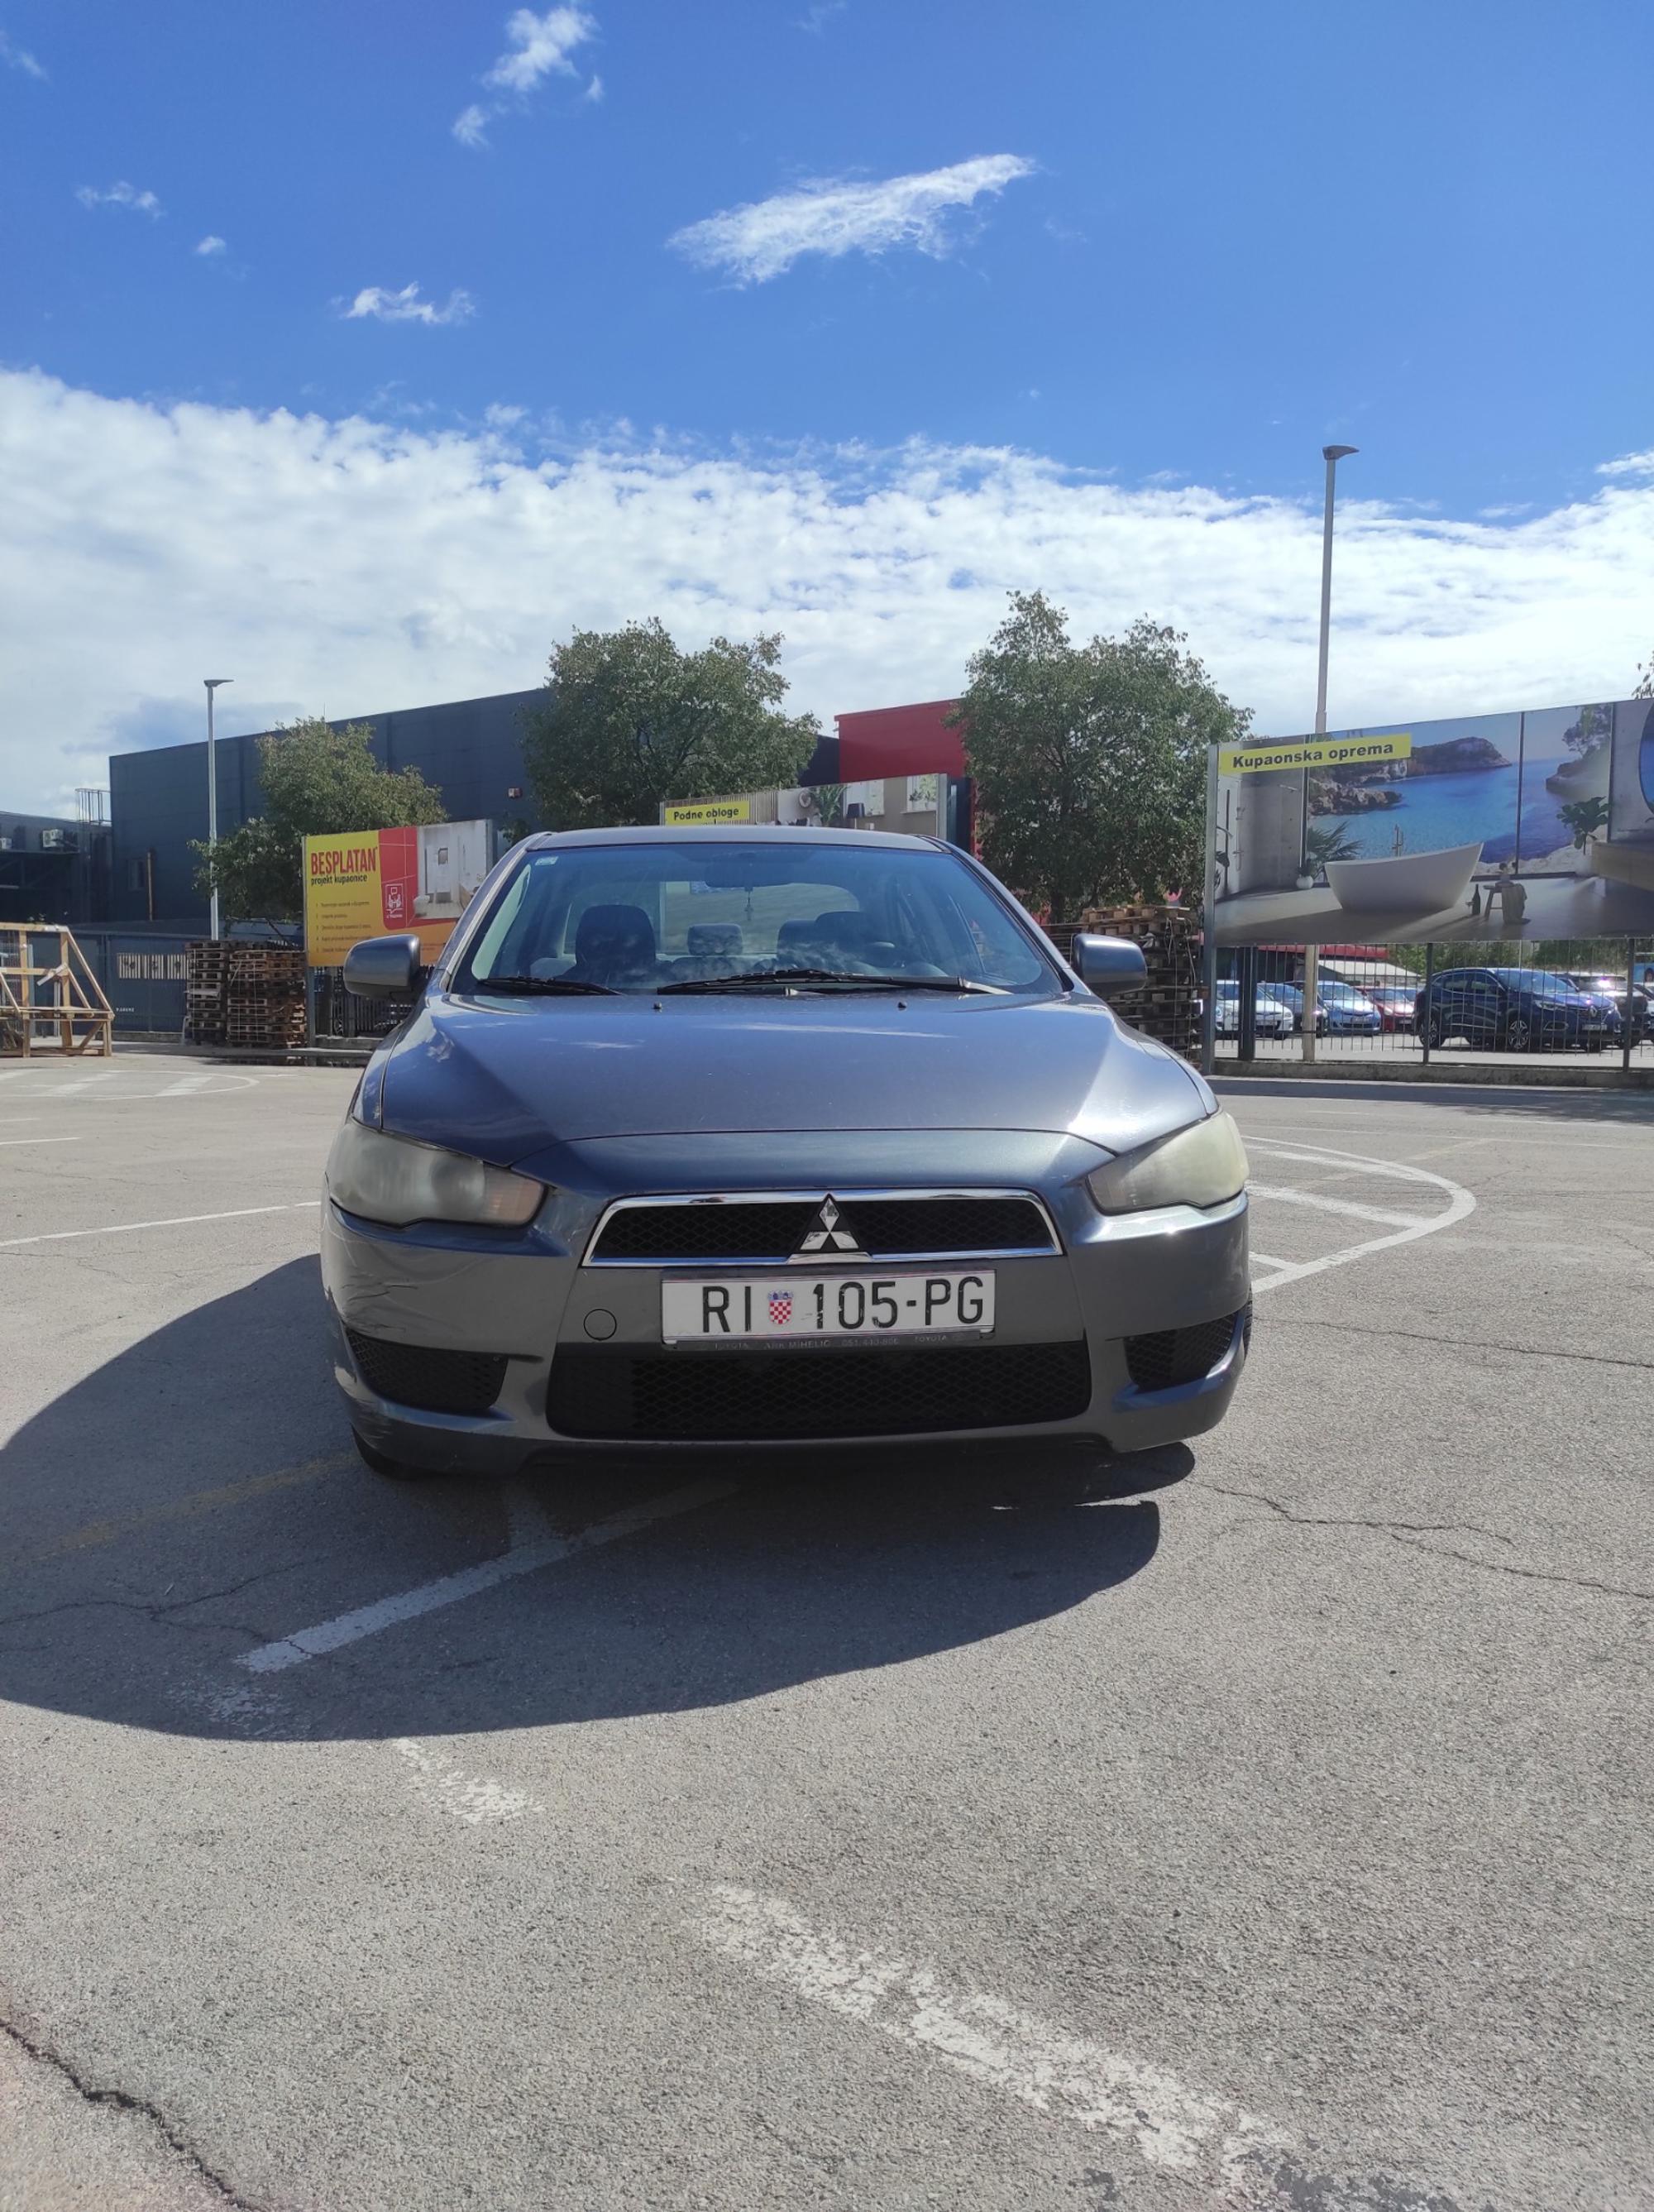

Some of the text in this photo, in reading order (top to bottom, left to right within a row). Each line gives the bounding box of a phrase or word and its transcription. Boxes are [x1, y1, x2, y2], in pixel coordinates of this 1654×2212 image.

[1232, 744, 1393, 769] Kupaonska oprema
[674, 808, 739, 821] Podne obloge
[311, 848, 376, 874] BESPLATAN
[311, 874, 368, 886] projekt kupaonice
[702, 1276, 984, 1333] RI 105-PG
[915, 1334, 947, 1343] TOYOTA
